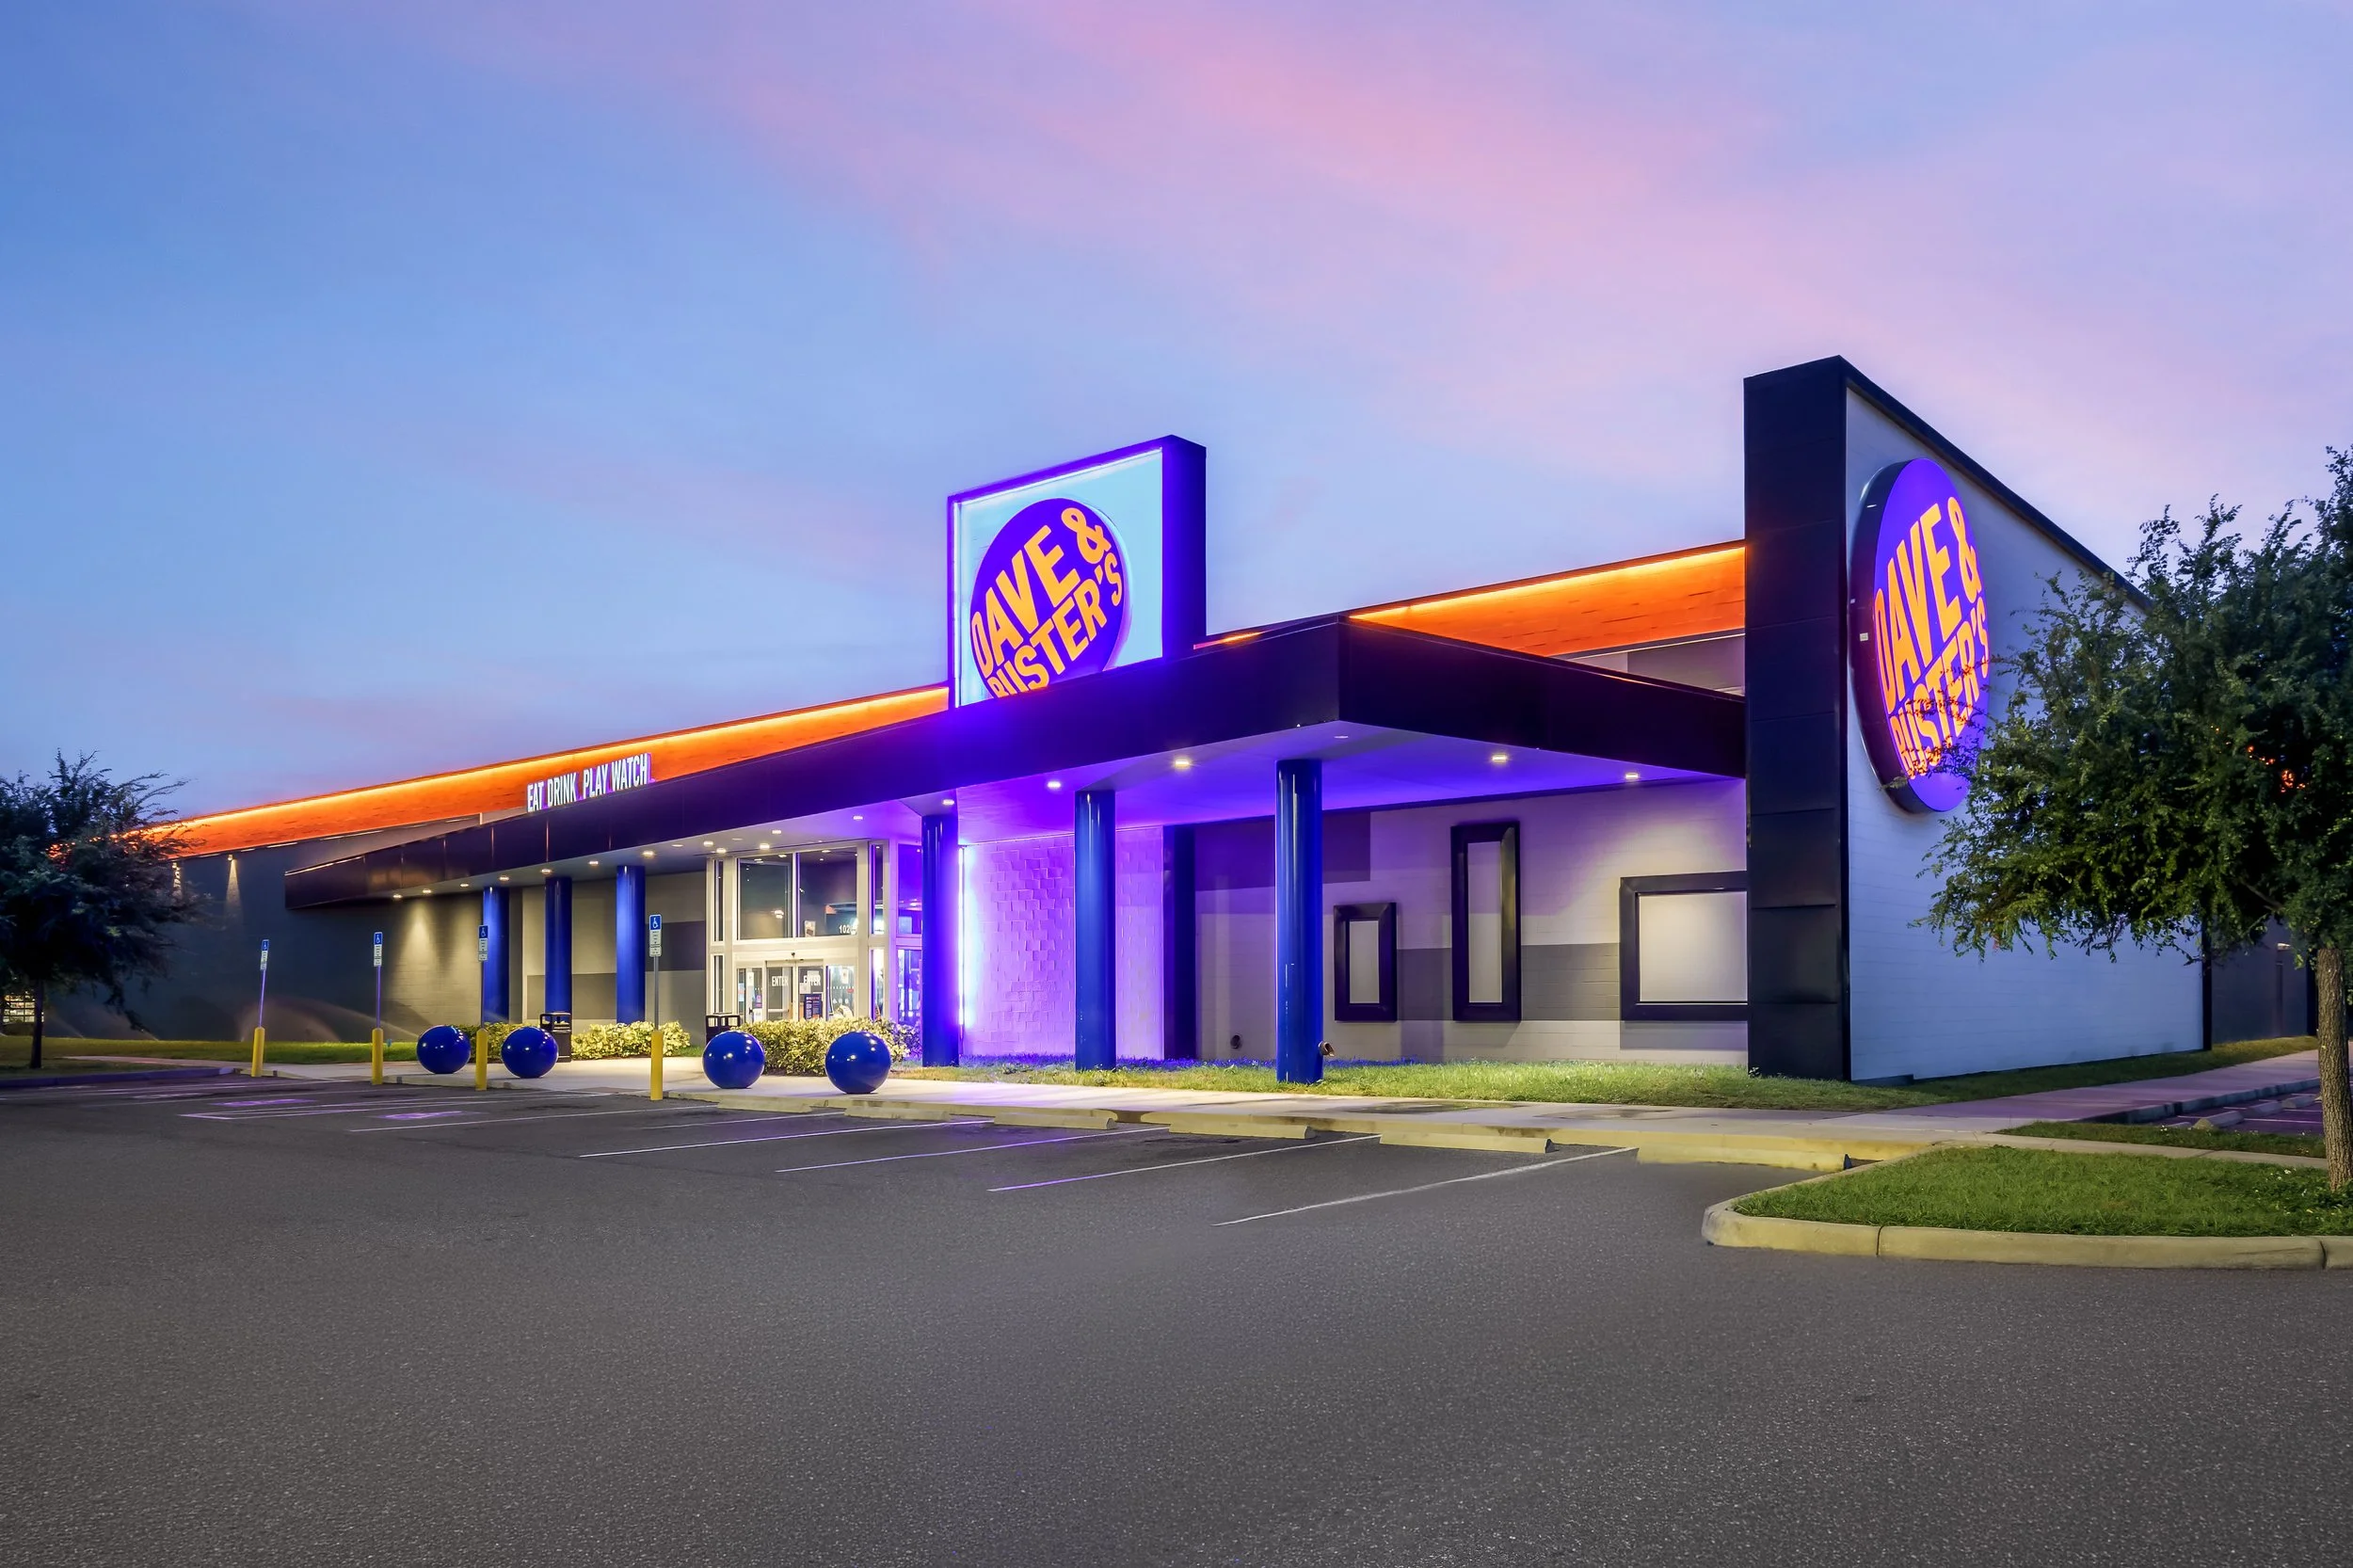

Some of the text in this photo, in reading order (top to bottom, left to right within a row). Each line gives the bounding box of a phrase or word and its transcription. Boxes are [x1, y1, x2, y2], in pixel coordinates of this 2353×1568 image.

[971, 507, 1112, 678] DAVE &
[1874, 496, 1982, 714] DAVE &
[1890, 596, 1990, 779] BUSTER'S
[527, 753, 648, 812] EAT DRINK PLAY WATCH
